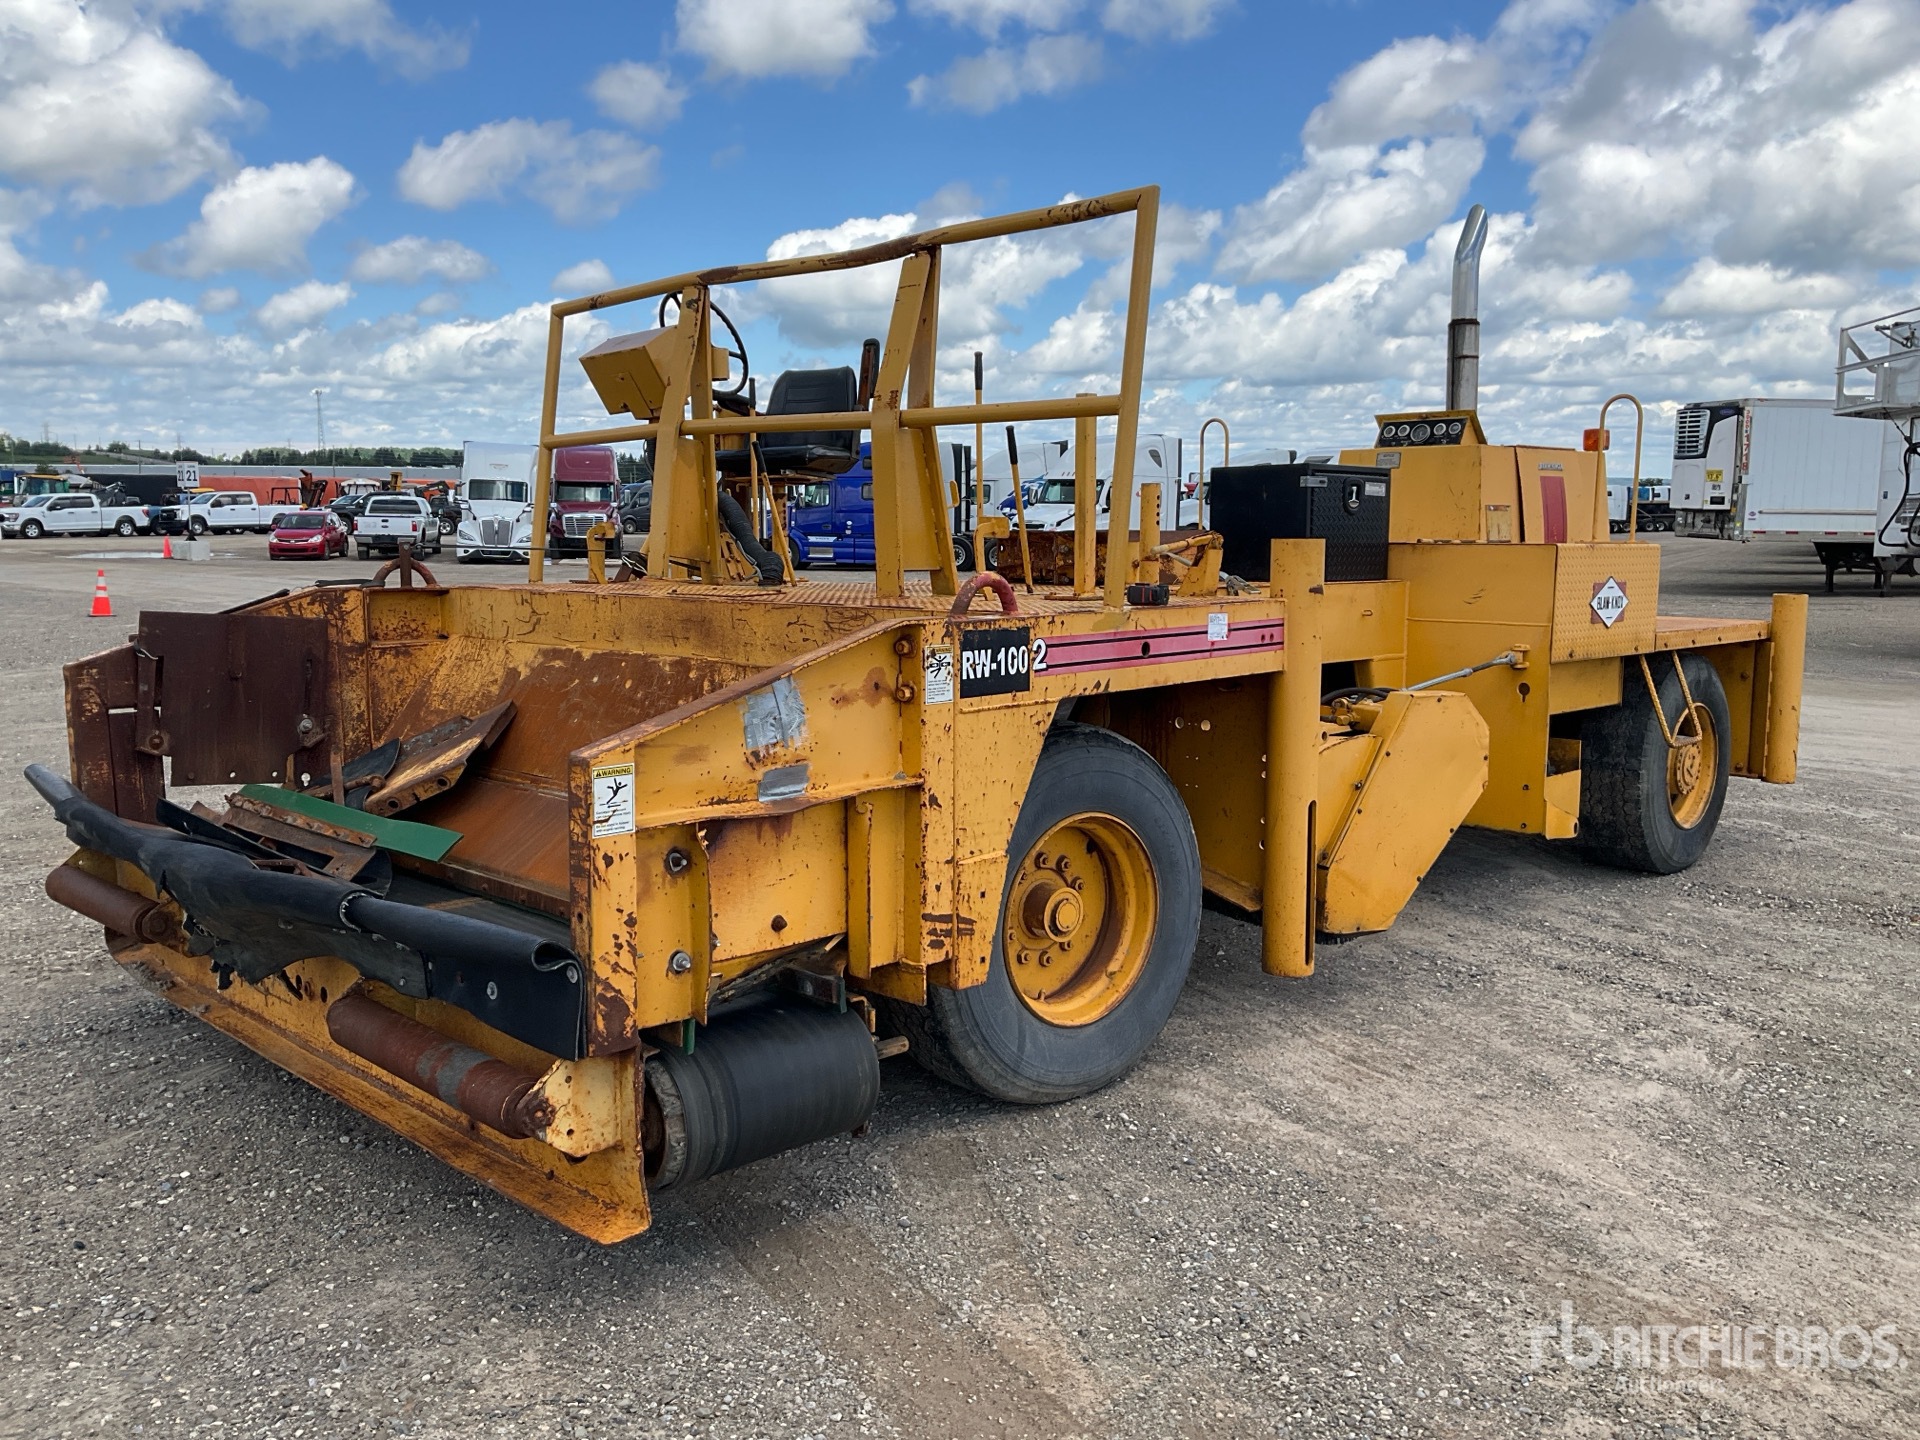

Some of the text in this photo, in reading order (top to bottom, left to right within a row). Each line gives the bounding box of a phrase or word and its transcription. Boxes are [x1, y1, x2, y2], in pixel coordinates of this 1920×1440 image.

[186, 470, 198, 482] 21
[1031, 638, 1047, 671] 2
[602, 767, 631, 777] WARNING
